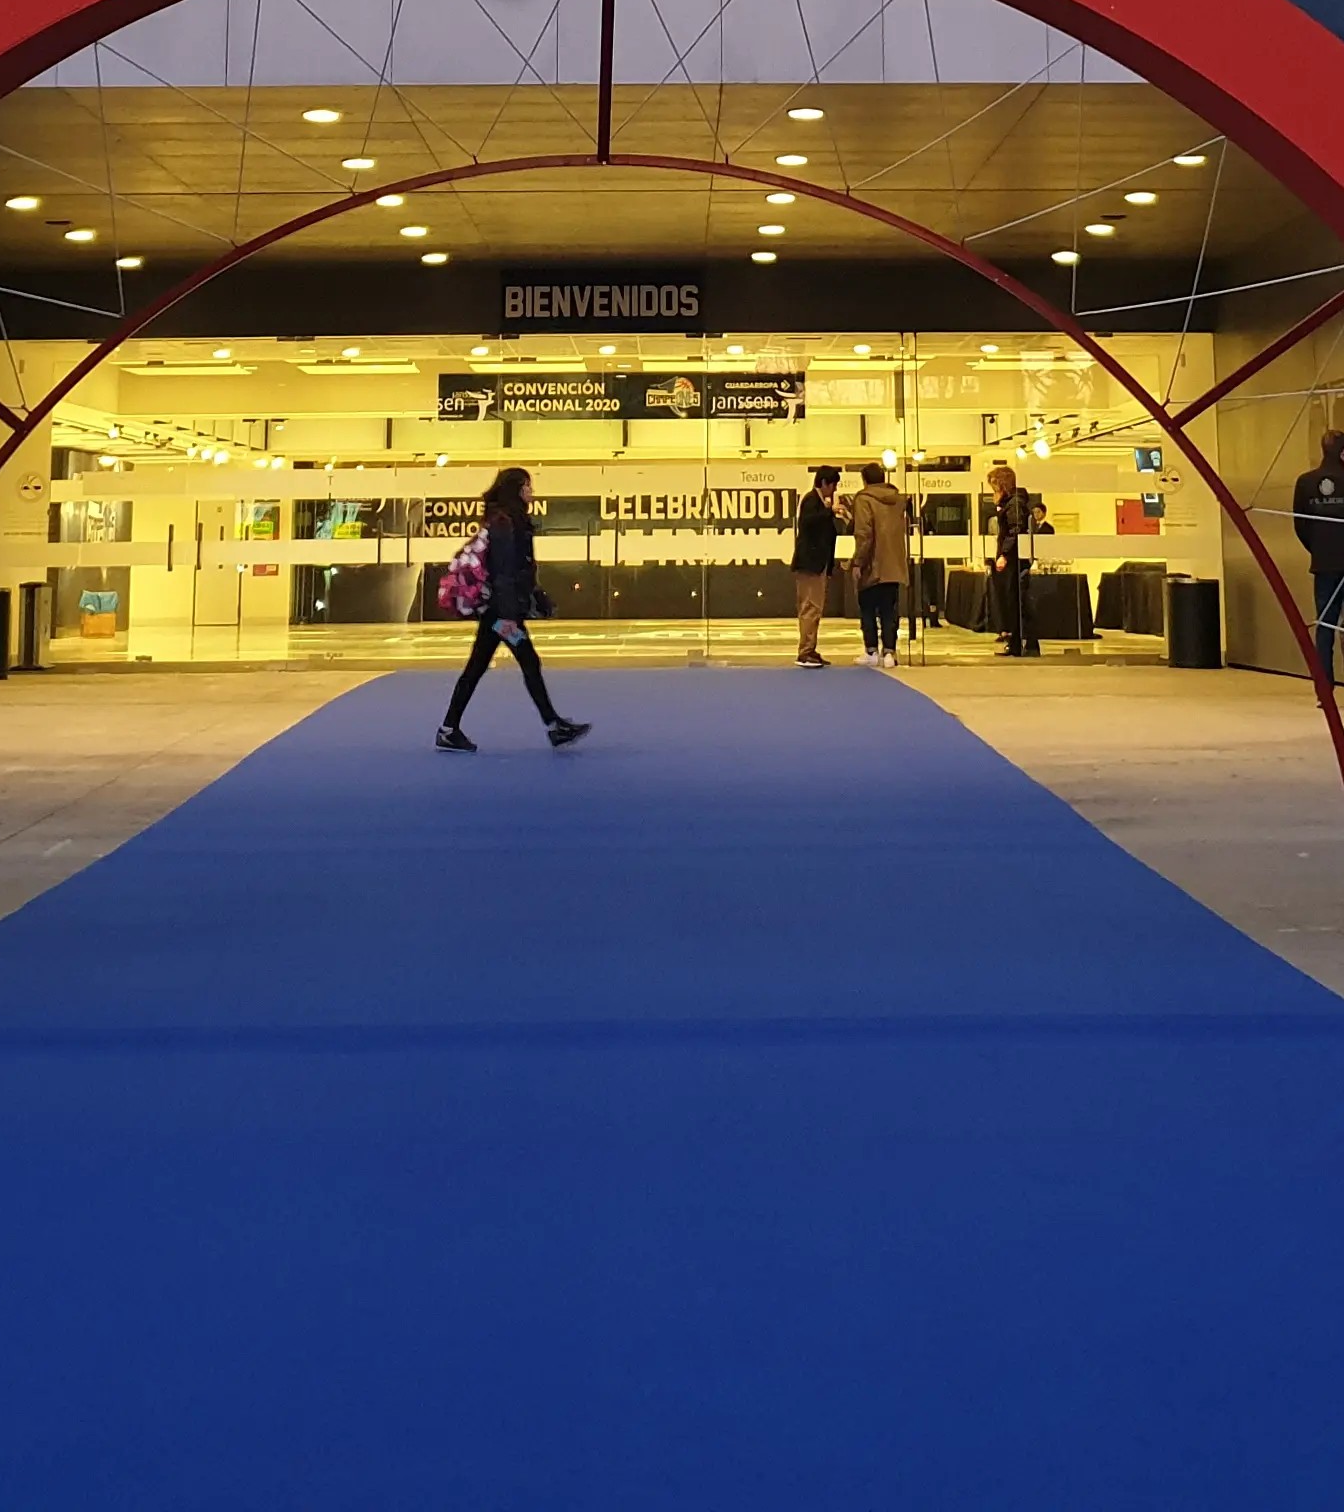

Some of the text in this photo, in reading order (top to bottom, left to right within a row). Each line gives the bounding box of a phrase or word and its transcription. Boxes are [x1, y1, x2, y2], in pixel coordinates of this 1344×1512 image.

[505, 284, 699, 318] BIENVENIDOS
[503, 379, 606, 395] CONVENCIÓN
[503, 398, 620, 412] NACIONAL 2020
[741, 471, 775, 483] Teatro
[921, 476, 952, 489] Teatro
[600, 490, 775, 520] CELEBRANDO
